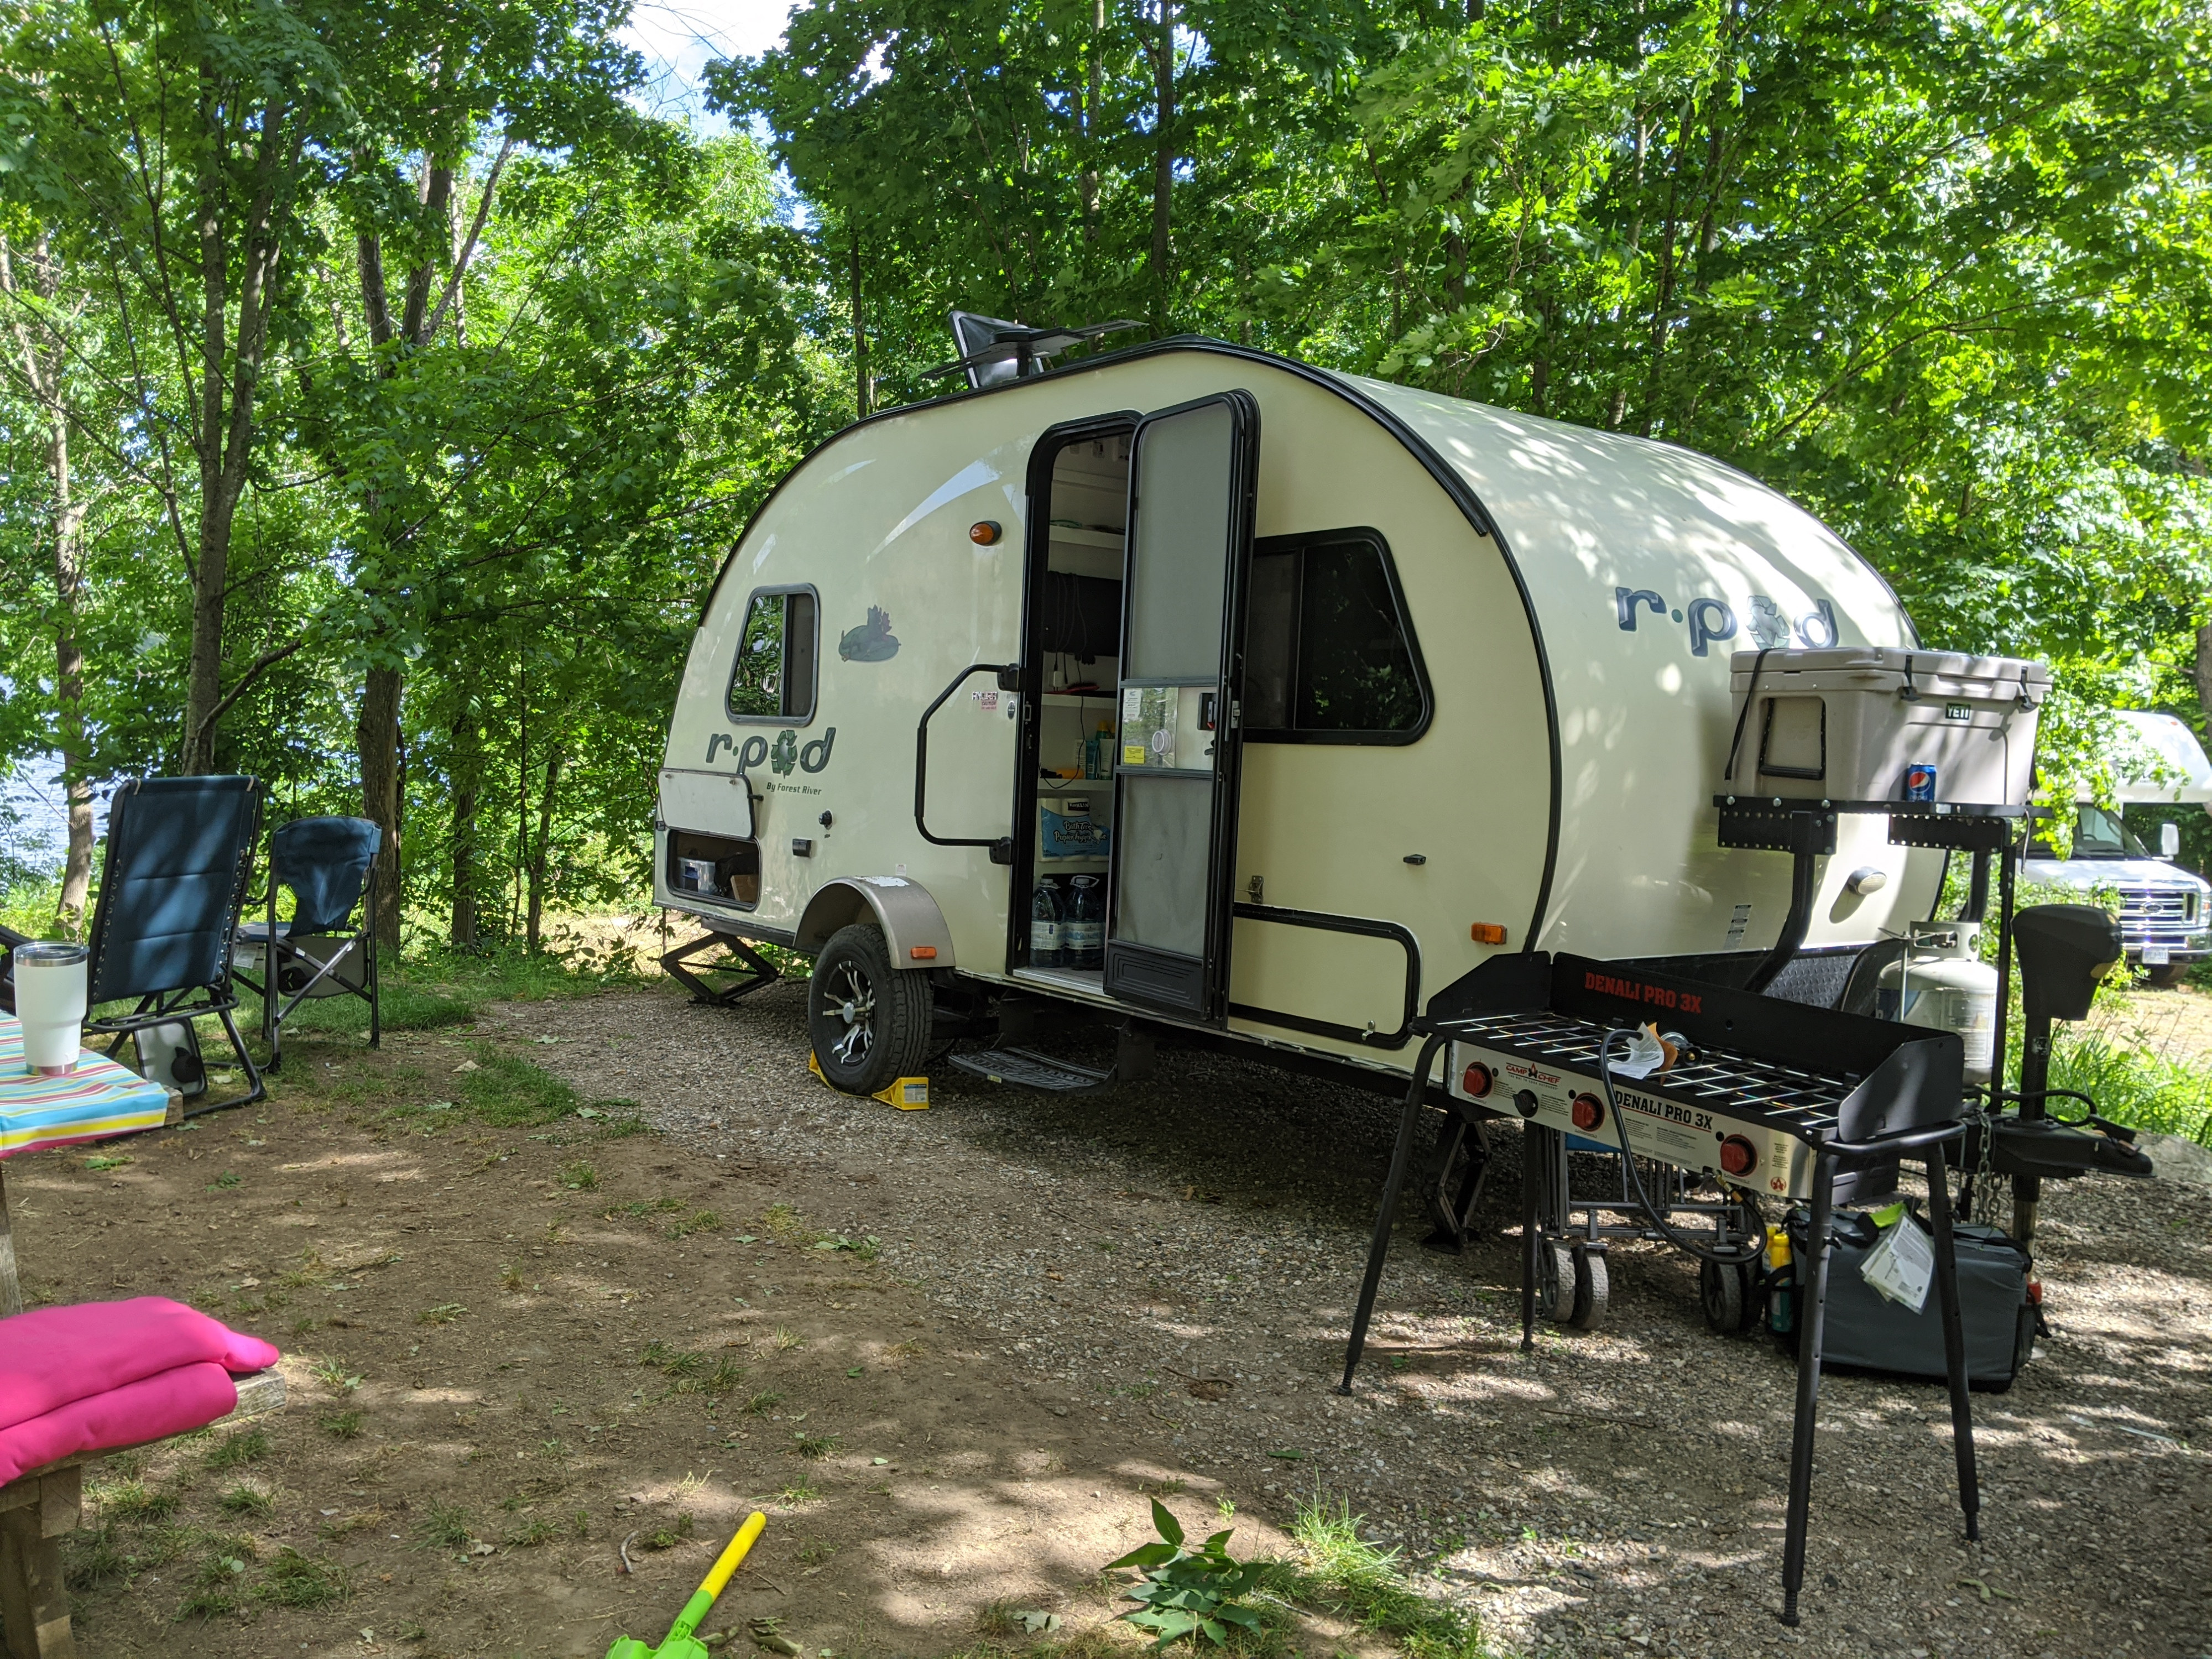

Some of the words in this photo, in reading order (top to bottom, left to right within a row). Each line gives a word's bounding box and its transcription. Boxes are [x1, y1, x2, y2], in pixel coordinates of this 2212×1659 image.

[1947, 706, 1968, 718] YETI
[766, 782, 775, 792] By
[778, 783, 800, 793] Forest
[802, 786, 822, 795] River
[1585, 972, 1640, 1001] DENALI
[1644, 985, 1676, 1008] PRO
[1680, 993, 1702, 1014] 3X
[1506, 1065, 1527, 1075] CAMP
[1538, 1074, 1560, 1084] CHEF
[1615, 1090, 1662, 1115] DENALI
[1665, 1104, 1692, 1124] PRO
[1695, 1113, 1713, 1130] 3X
